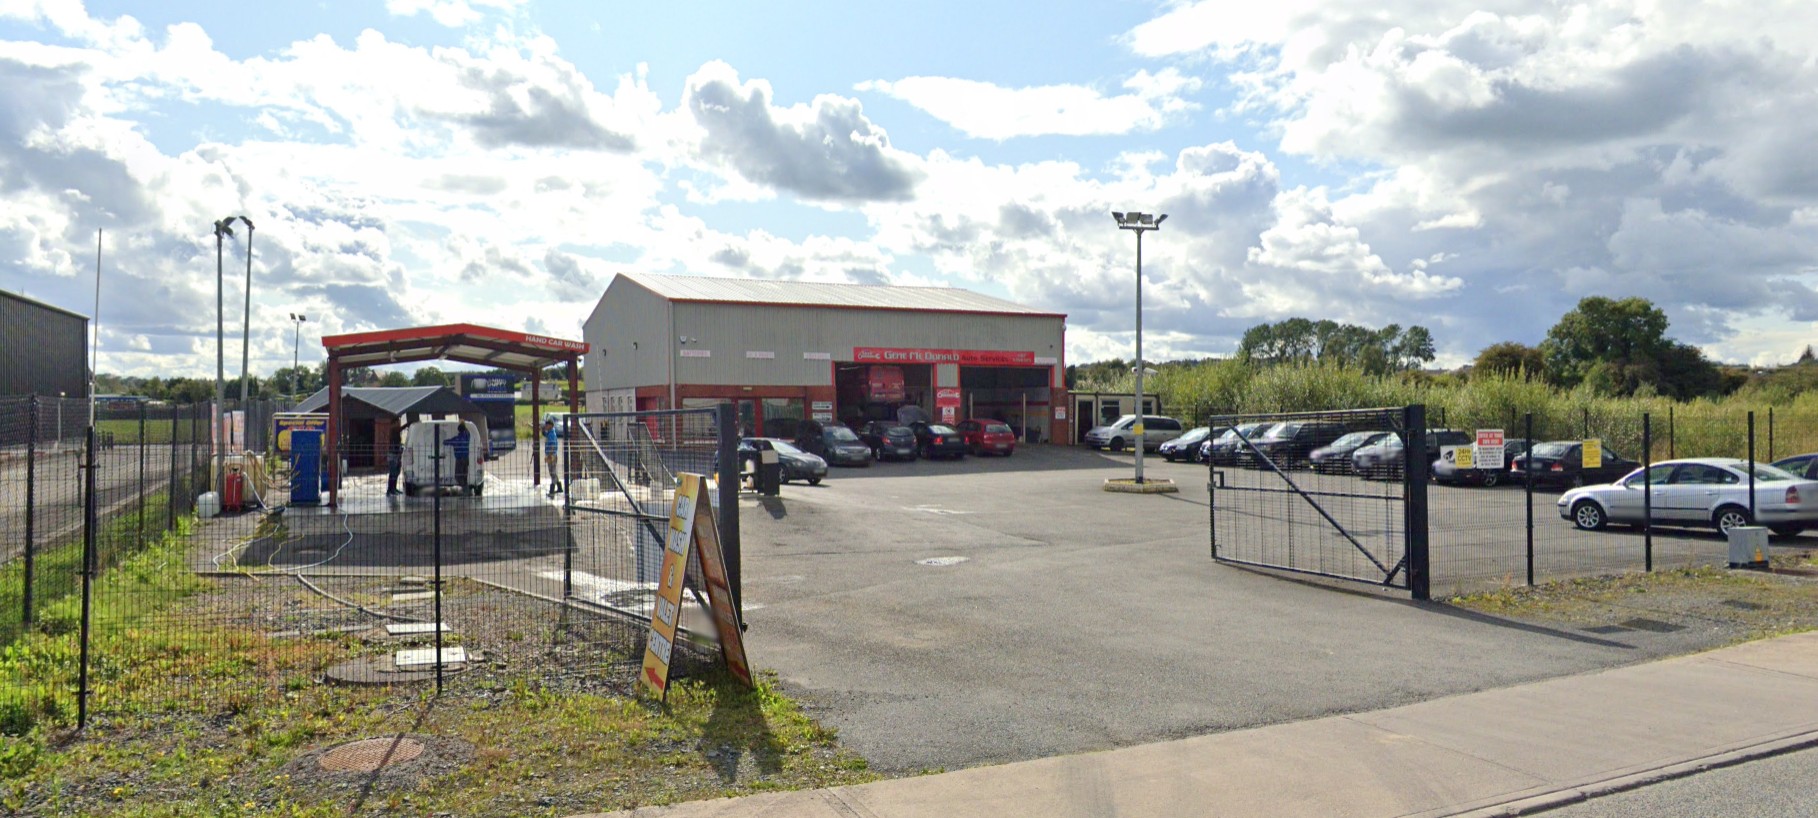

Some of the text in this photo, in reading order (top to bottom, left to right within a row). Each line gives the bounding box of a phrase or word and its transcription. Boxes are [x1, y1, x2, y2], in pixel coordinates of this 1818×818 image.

[525, 335, 585, 350] HAND CAR WASH
[677, 495, 690, 519] CAR
[669, 528, 687, 556] WASH
[667, 564, 675, 589] &
[657, 596, 675, 627] VALET
[648, 629, 672, 665] CENTRE
